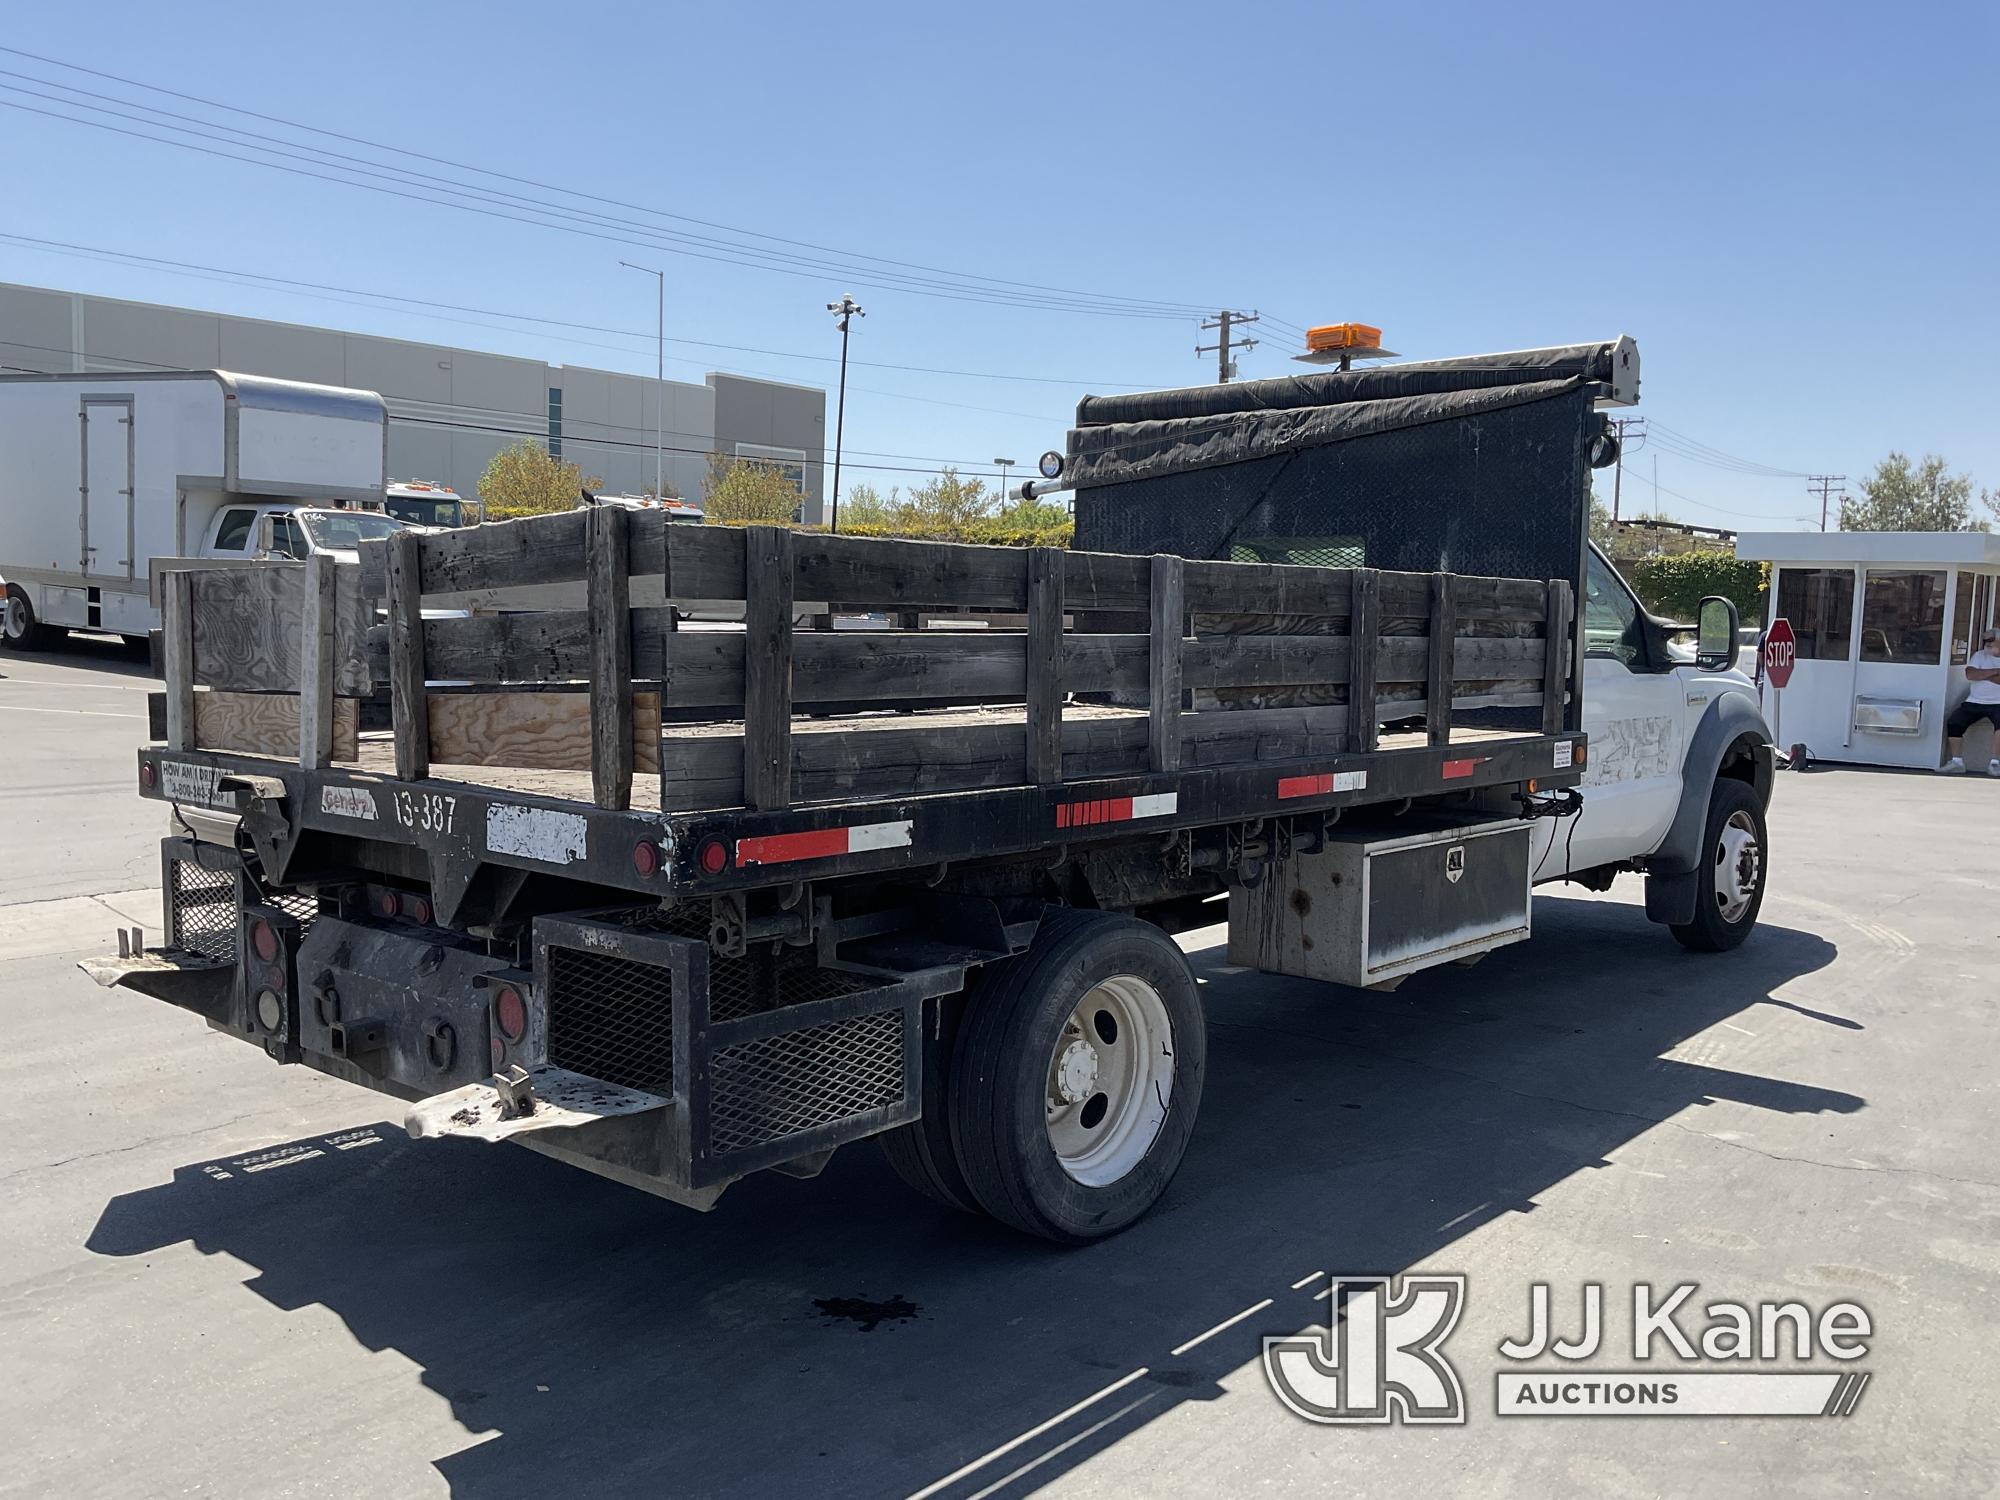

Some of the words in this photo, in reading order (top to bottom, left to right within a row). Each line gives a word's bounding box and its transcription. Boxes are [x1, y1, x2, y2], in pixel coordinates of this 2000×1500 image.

[1767, 641, 1793, 667] STOP
[163, 763, 179, 777] HOW
[182, 766, 193, 779] AM
[394, 790, 456, 834] 13-387
